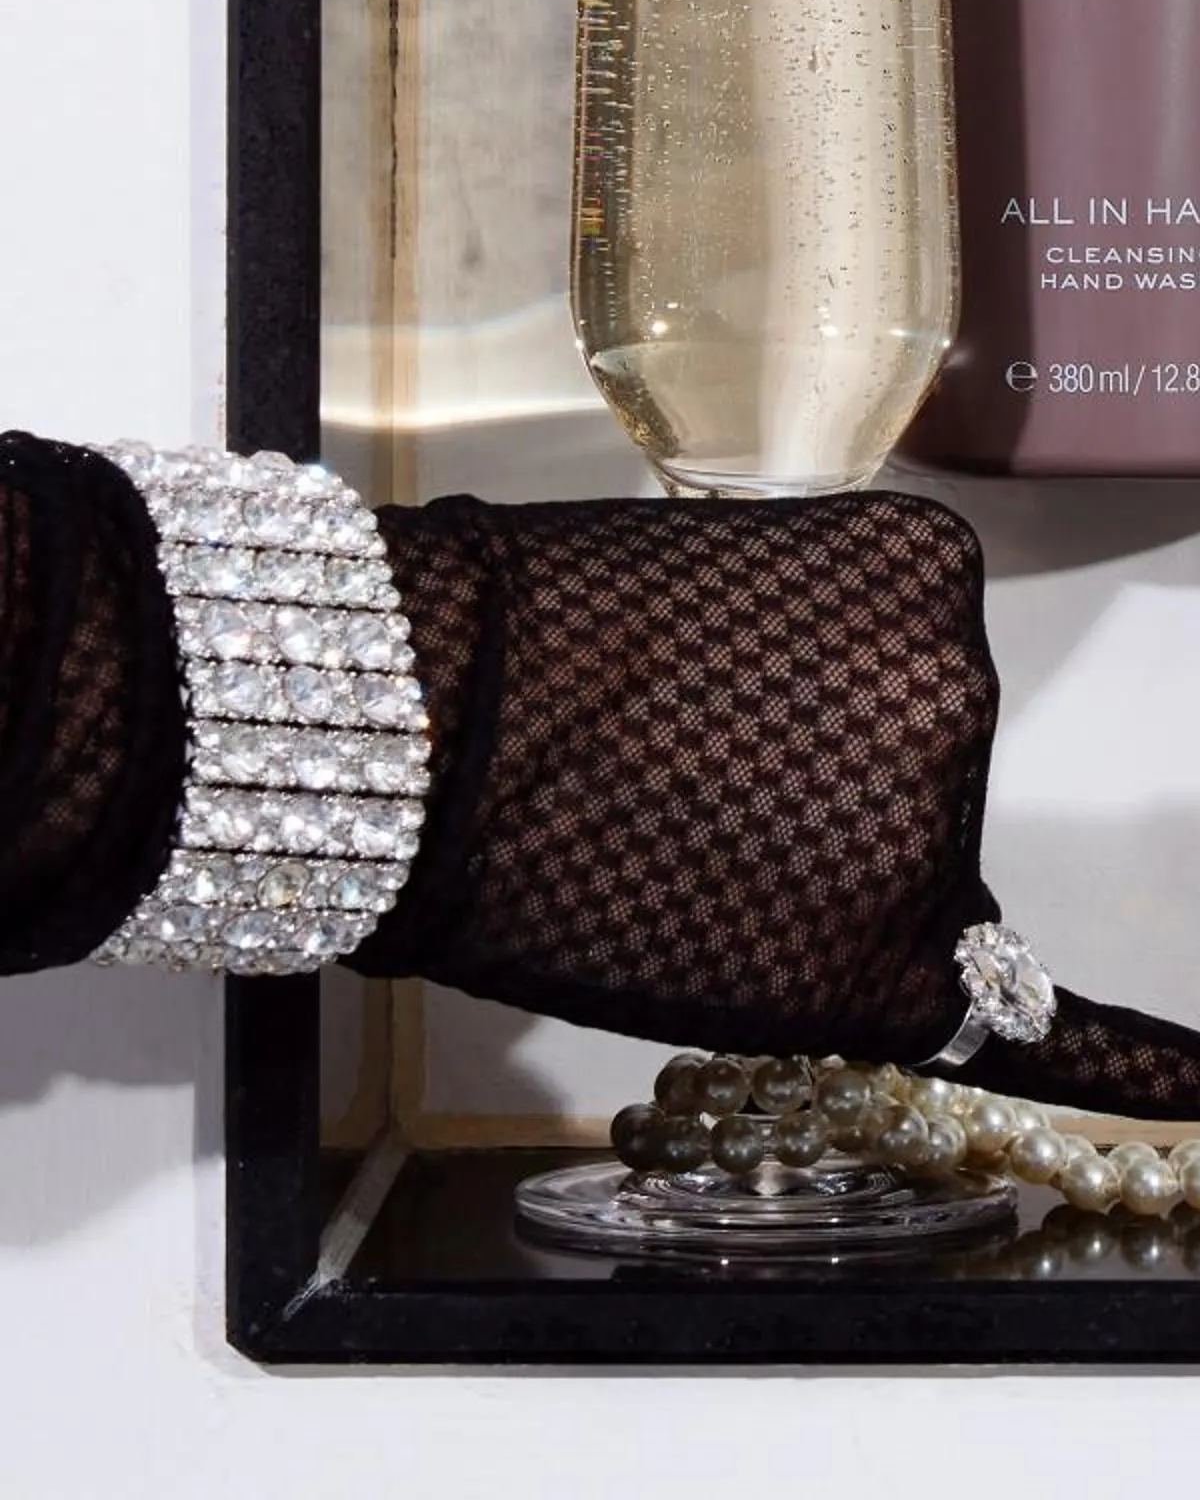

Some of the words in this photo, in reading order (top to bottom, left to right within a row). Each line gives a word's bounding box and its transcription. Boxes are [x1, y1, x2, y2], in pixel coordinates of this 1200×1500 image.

[1000, 197, 1075, 225] ALL
[1088, 197, 1128, 225] IN
[1040, 272, 1124, 290] HAND
[1049, 363, 1094, 393] 380
[1151, 363, 1200, 393] 12.8
